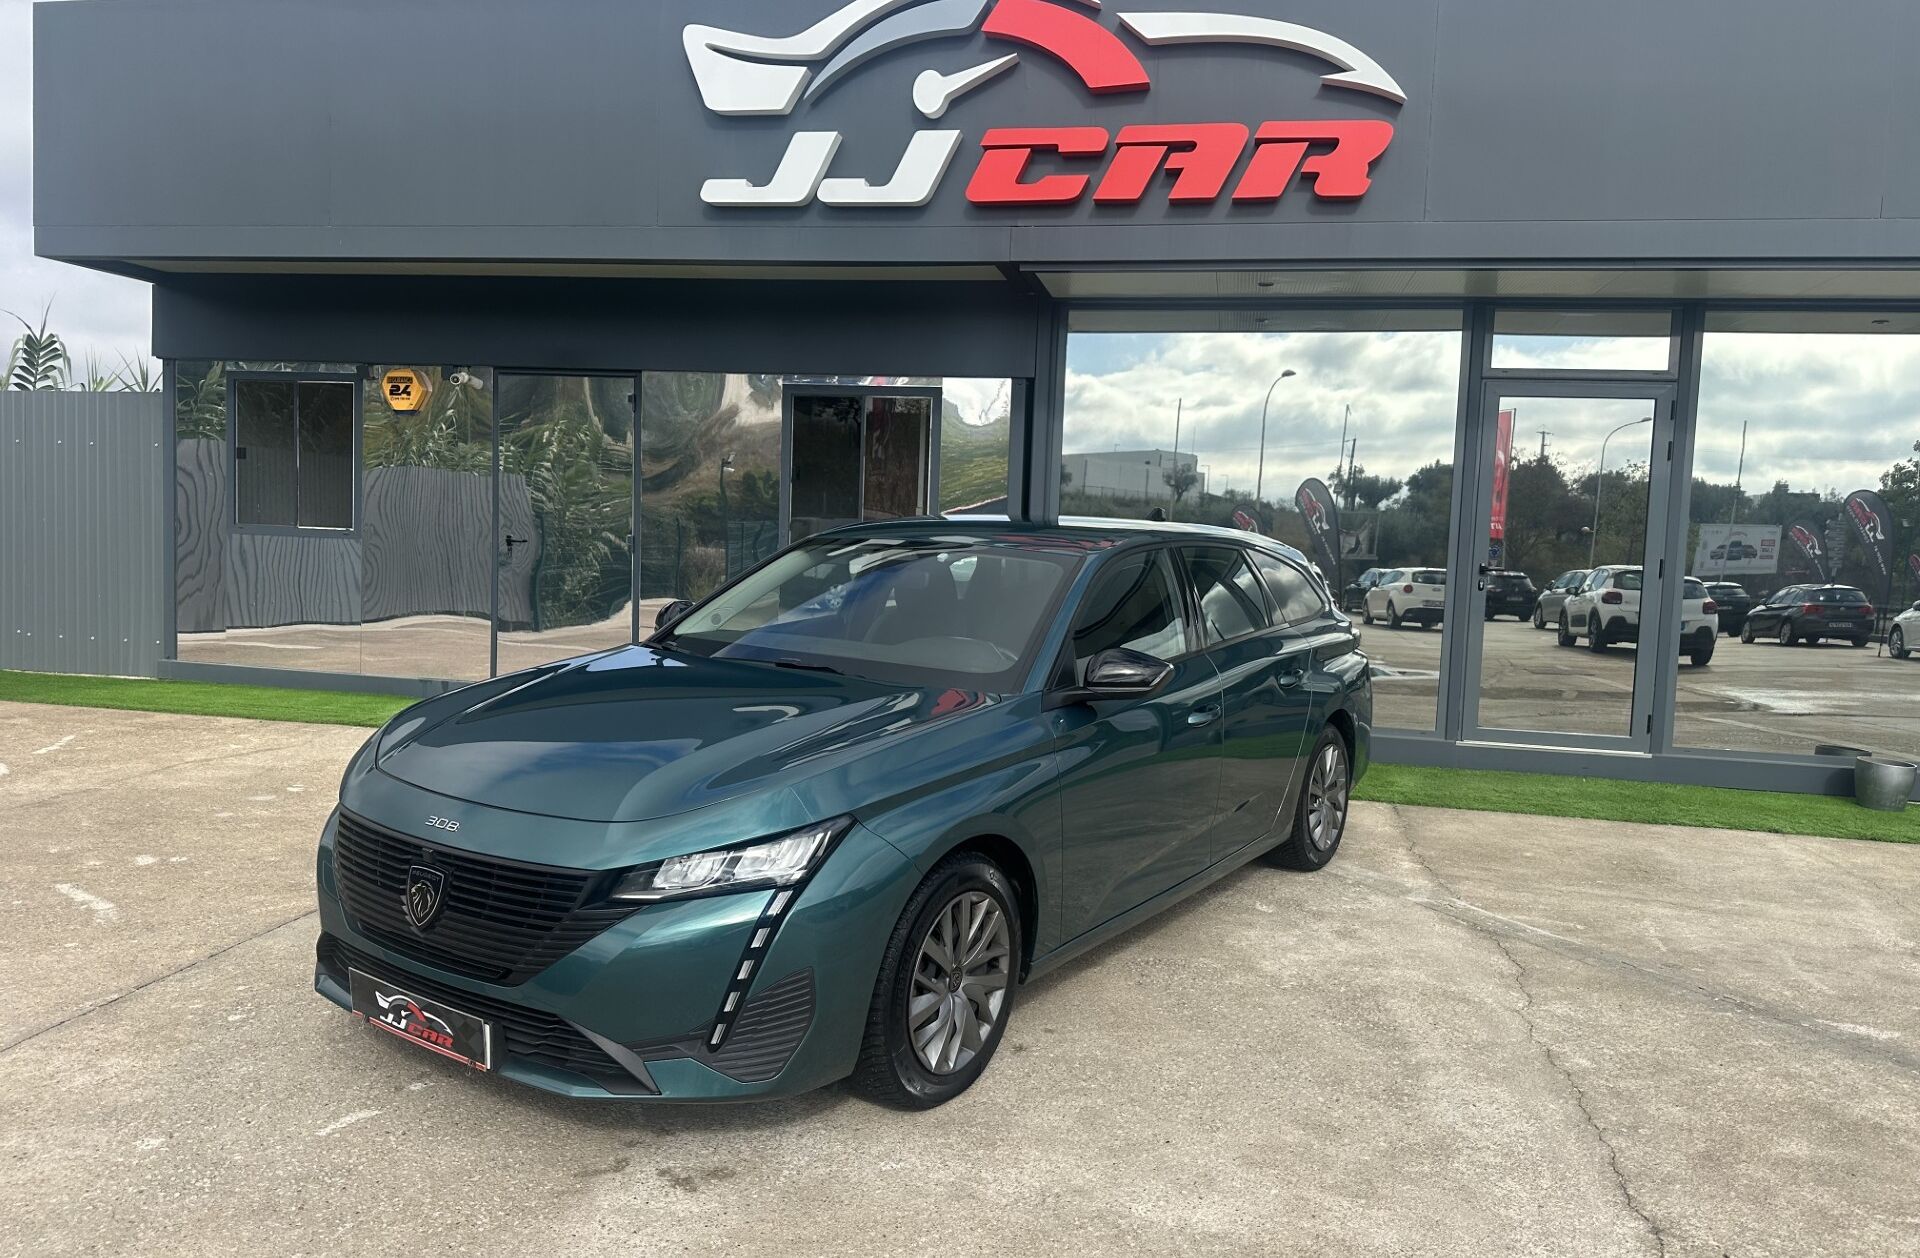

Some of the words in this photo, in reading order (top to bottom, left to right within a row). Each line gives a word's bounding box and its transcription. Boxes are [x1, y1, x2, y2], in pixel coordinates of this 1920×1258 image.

[965, 120, 1395, 206] CAR
[389, 384, 411, 396] 24
[425, 815, 460, 832] 308
